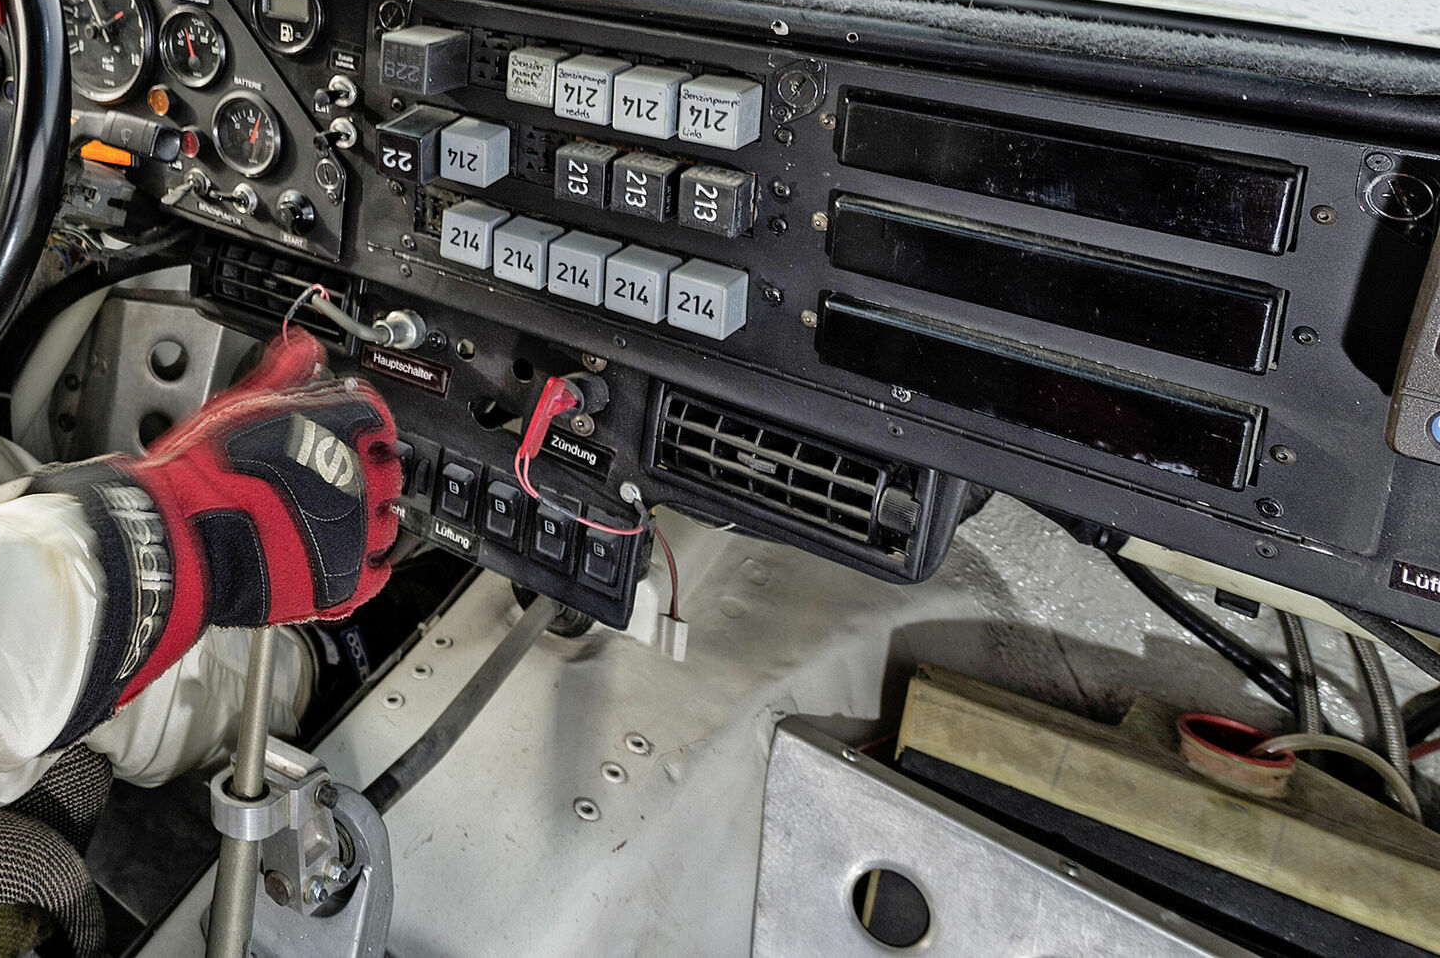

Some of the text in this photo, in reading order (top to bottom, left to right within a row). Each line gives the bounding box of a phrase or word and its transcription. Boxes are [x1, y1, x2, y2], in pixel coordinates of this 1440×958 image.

[563, 83, 598, 108] 214
[622, 95, 659, 121] 214
[689, 105, 729, 132] 214
[447, 148, 478, 172] 214
[567, 159, 589, 196] 213
[624, 169, 648, 208] 213
[693, 183, 719, 222] 213
[449, 227, 480, 252] 214
[503, 247, 535, 273] 214
[556, 262, 590, 288] 214
[613, 277, 649, 305] 214
[677, 291, 715, 320] 214
[373, 353, 434, 381] Hauptschalter
[551, 435, 597, 466] Zündung
[435, 522, 470, 549] Lüftung
